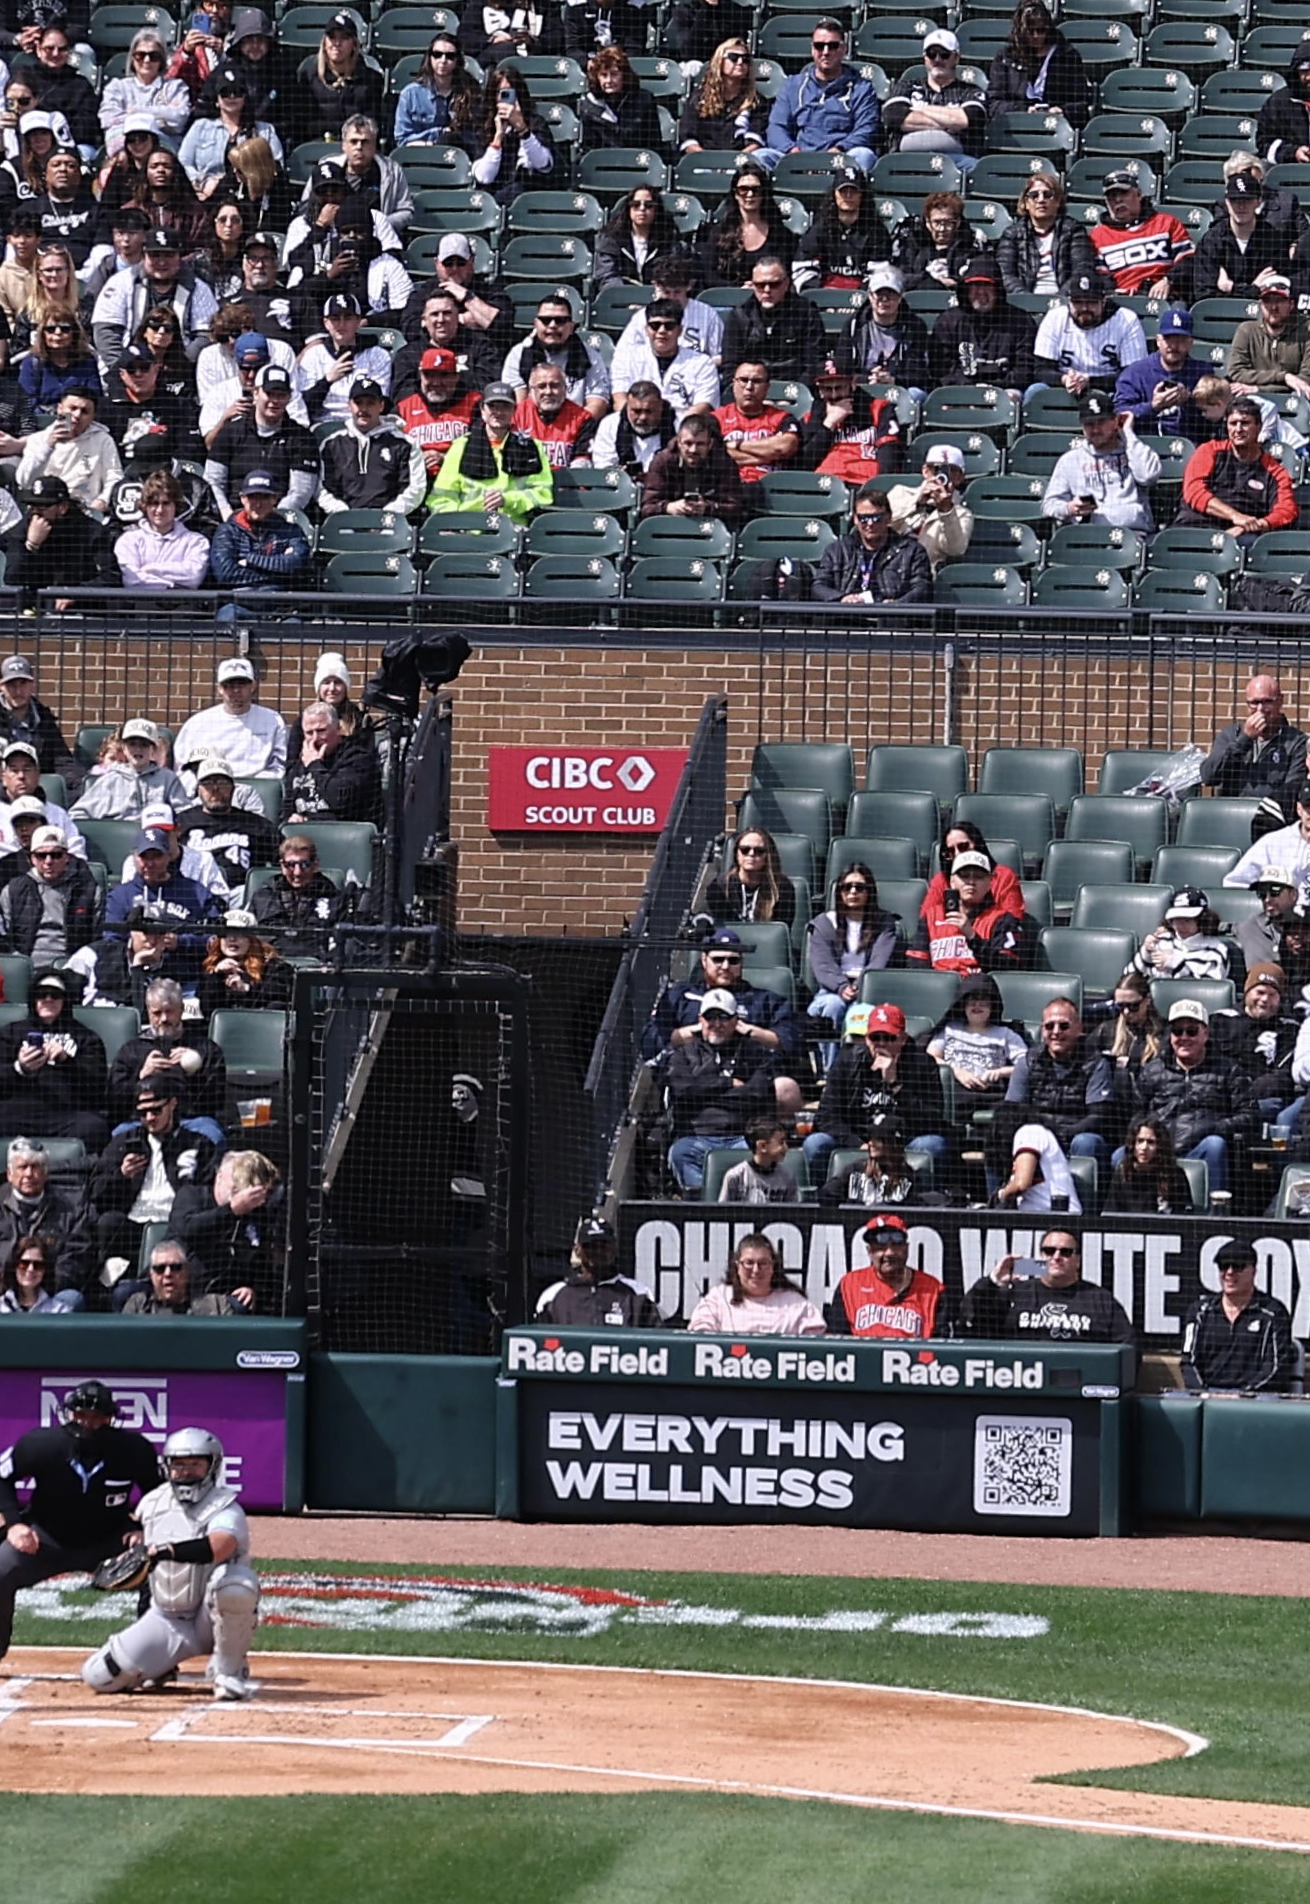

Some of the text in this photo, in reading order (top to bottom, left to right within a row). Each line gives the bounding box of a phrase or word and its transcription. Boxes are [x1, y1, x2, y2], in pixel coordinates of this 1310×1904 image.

[1104, 241, 1168, 271] SOX
[526, 756, 614, 790] CIBC
[525, 806, 656, 825] SCOUT CLUB
[224, 847, 251, 870] 45
[508, 1337, 669, 1376] Rate Field
[695, 1344, 856, 1383] Rate Field
[882, 1350, 1044, 1389] Rate Field
[548, 1411, 906, 1461] EVERYTHING
[546, 1460, 855, 1510] WELLNESS
